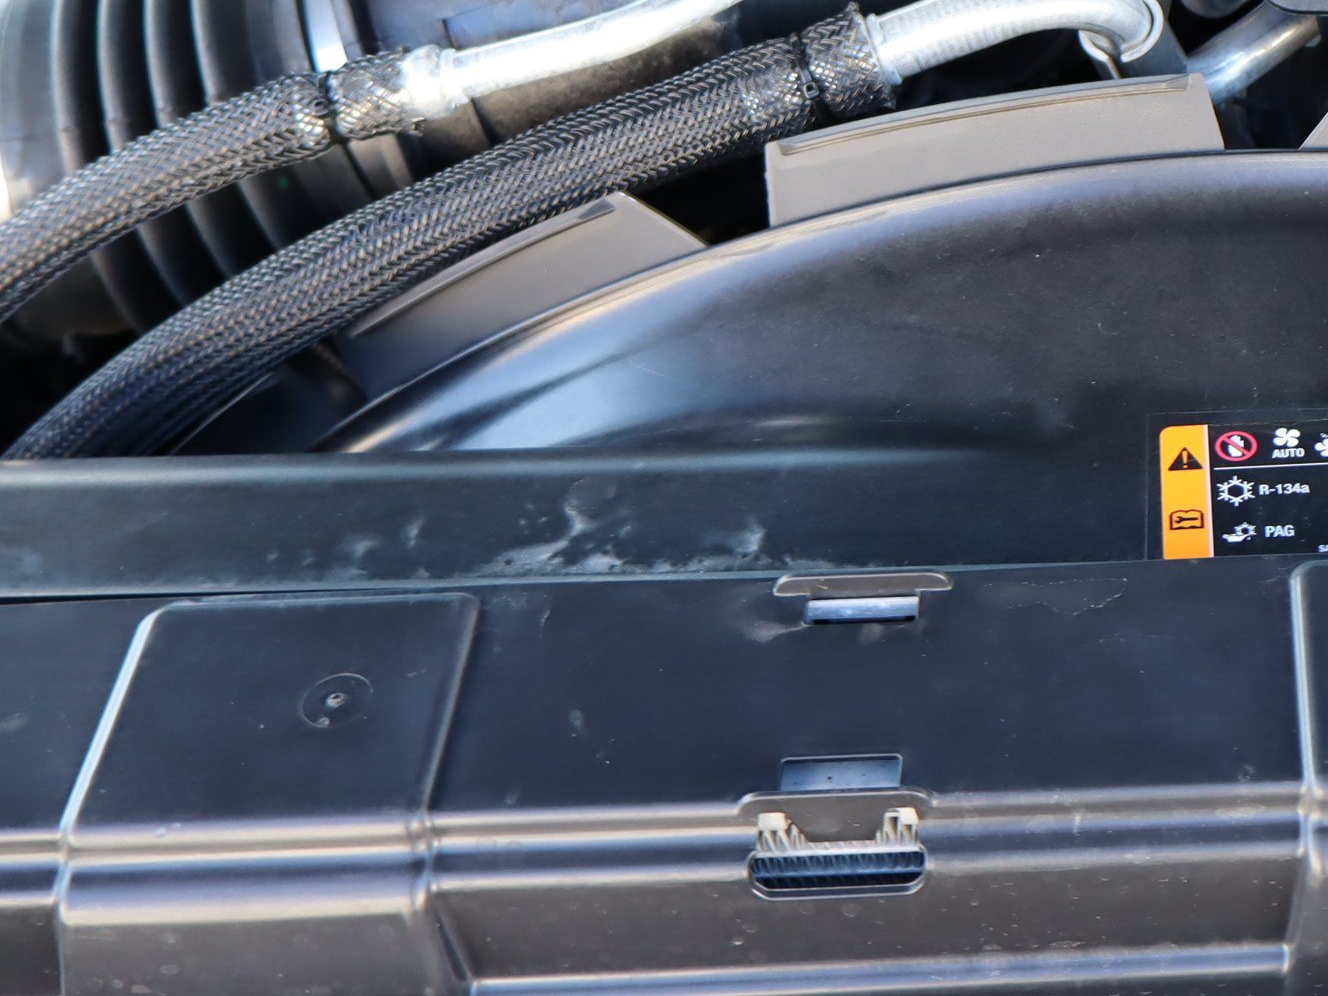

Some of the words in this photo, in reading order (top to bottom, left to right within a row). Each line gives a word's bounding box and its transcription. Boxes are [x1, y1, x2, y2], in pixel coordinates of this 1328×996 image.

[1272, 448, 1305, 459] AUTO
[1259, 484, 1310, 495] R-134a
[1265, 525, 1295, 537] PAG
